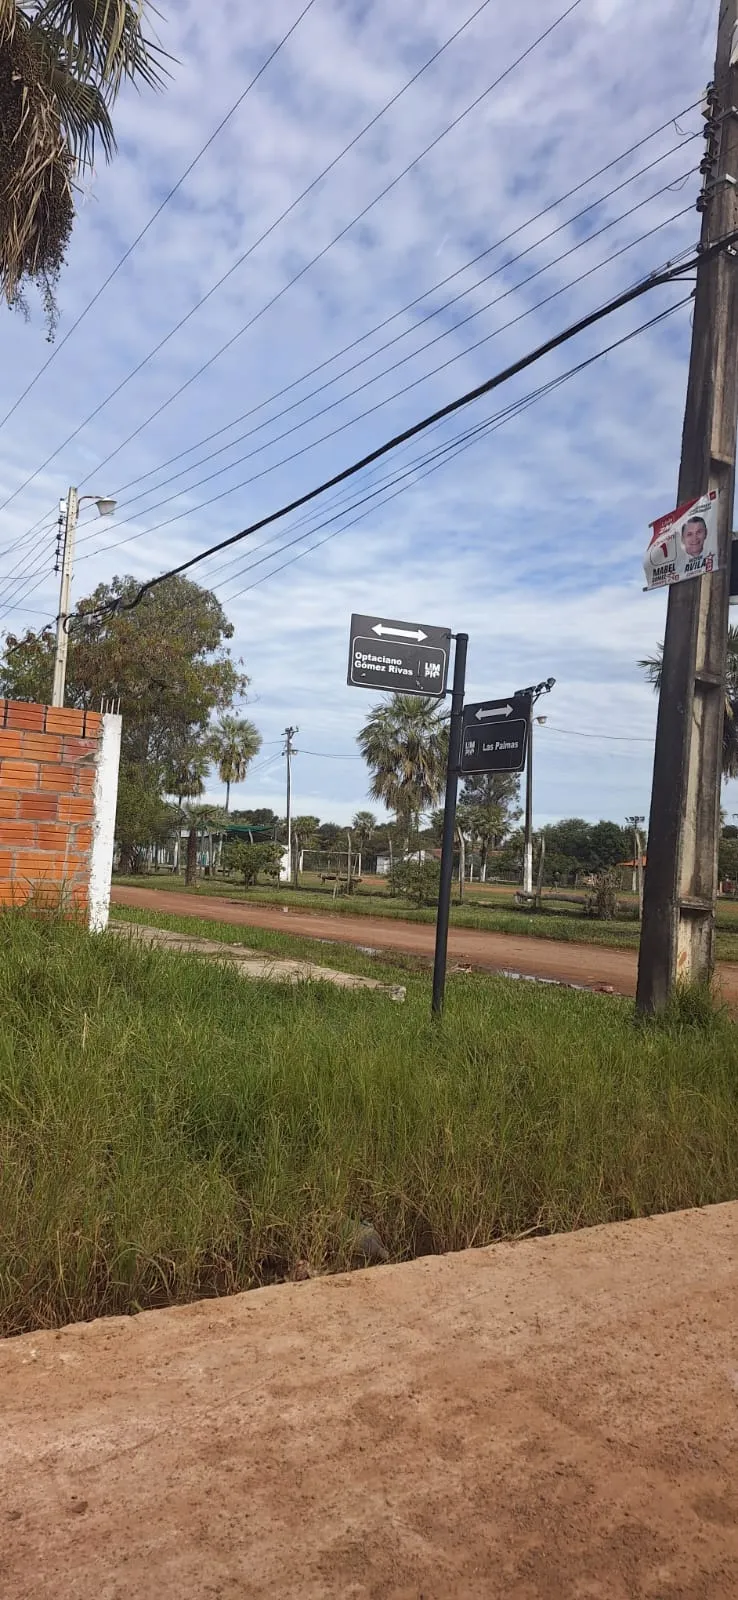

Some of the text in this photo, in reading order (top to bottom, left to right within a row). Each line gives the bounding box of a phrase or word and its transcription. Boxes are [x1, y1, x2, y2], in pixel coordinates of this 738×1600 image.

[653, 563, 676, 576] MABEL
[355, 652, 402, 665] Optaciano
[354, 660, 413, 676] Gómez Rivas
[482, 741, 519, 752] Las Palmas
